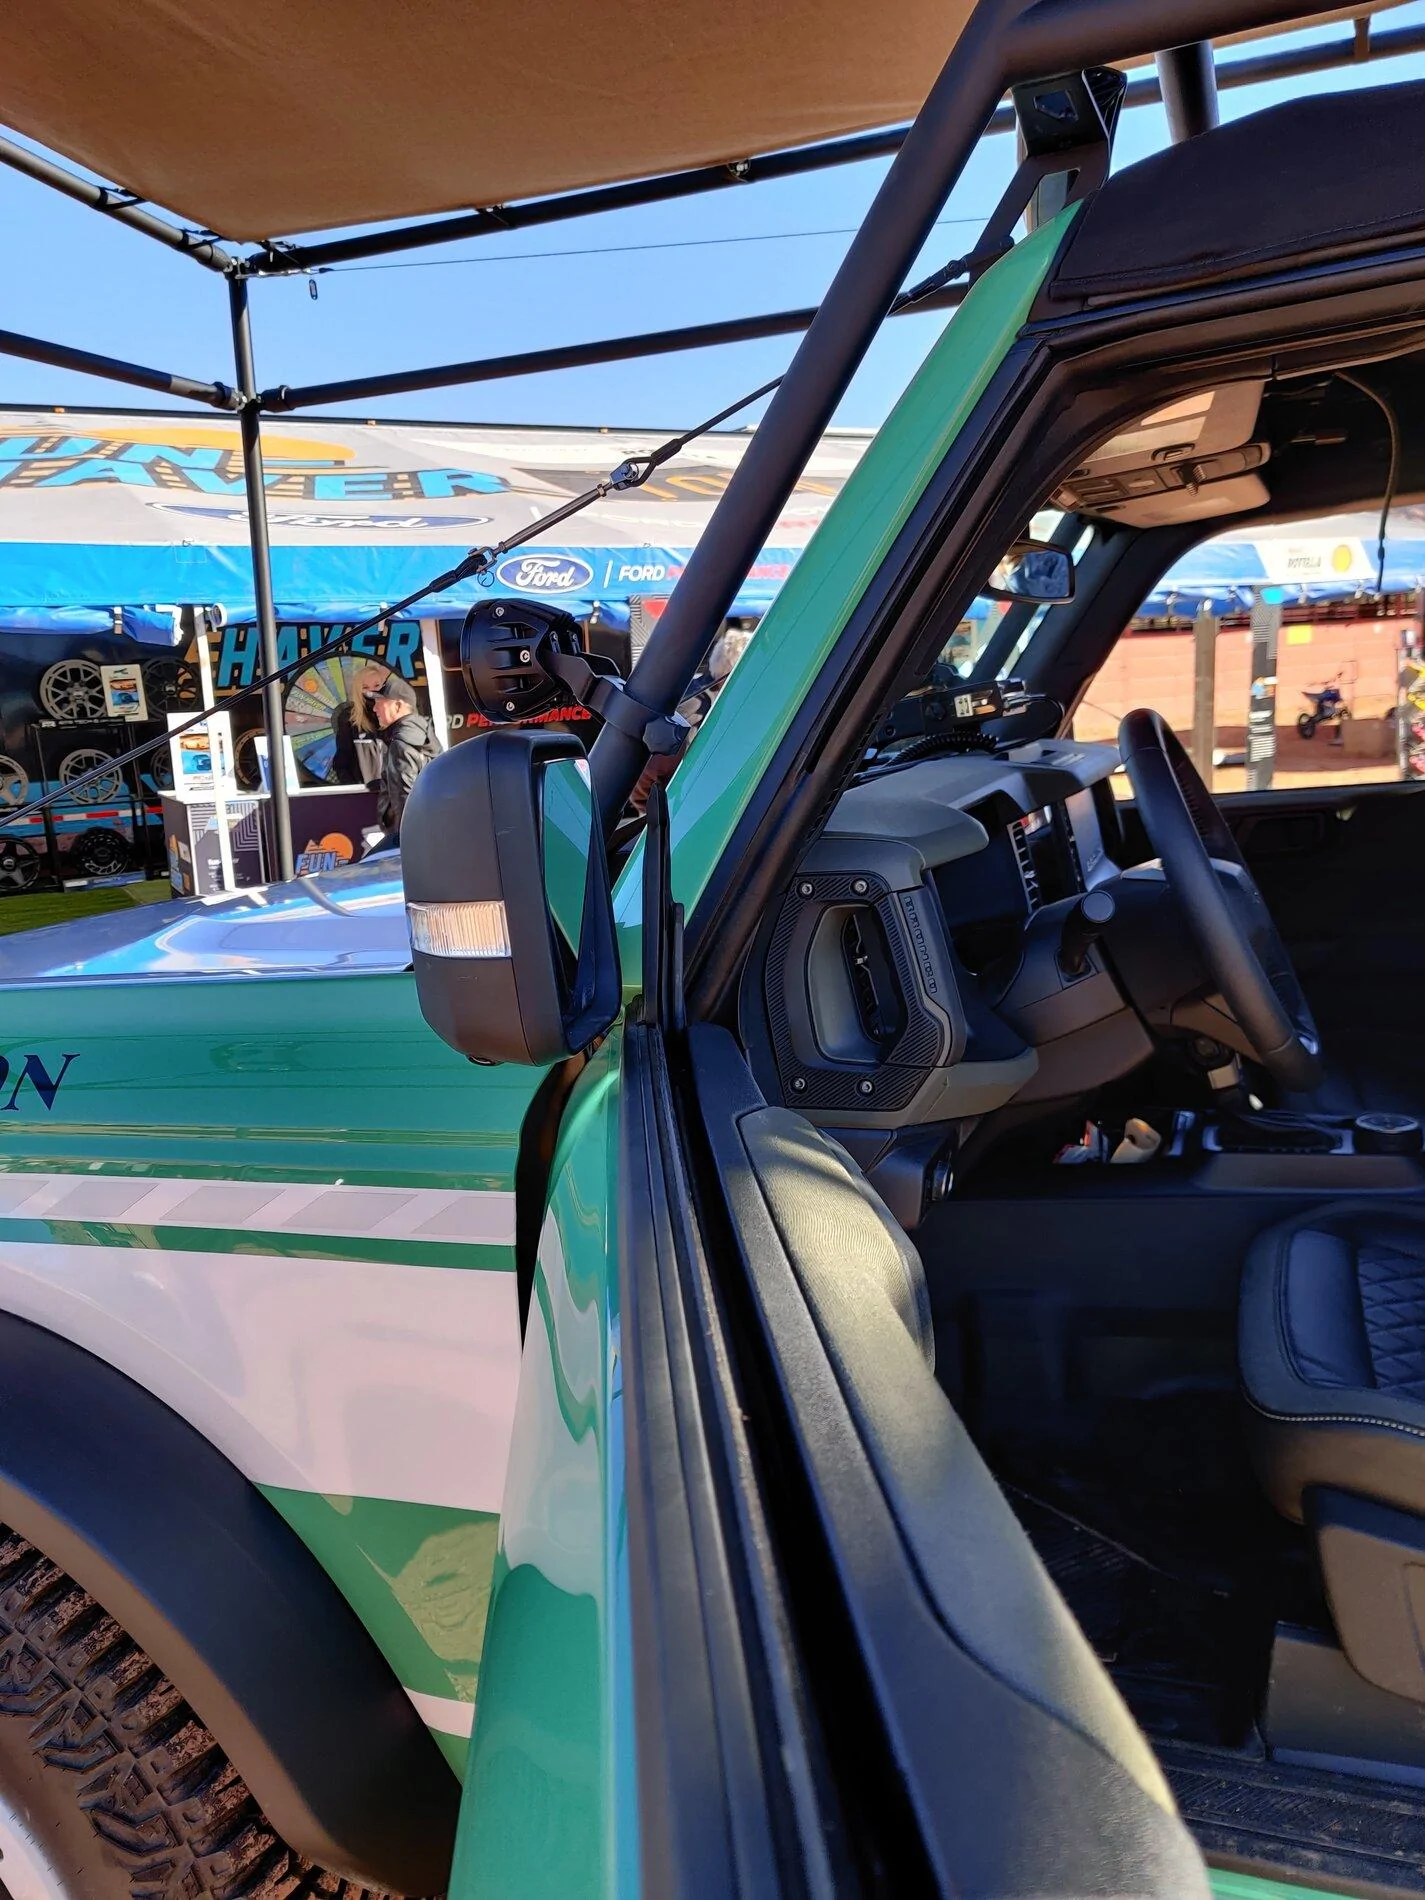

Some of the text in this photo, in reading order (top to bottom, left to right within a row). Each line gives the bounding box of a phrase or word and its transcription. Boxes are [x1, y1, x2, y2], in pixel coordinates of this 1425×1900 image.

[515, 558, 576, 588] Ford
[618, 565, 666, 582] FORD
[903, 896, 938, 994] BRONCO
